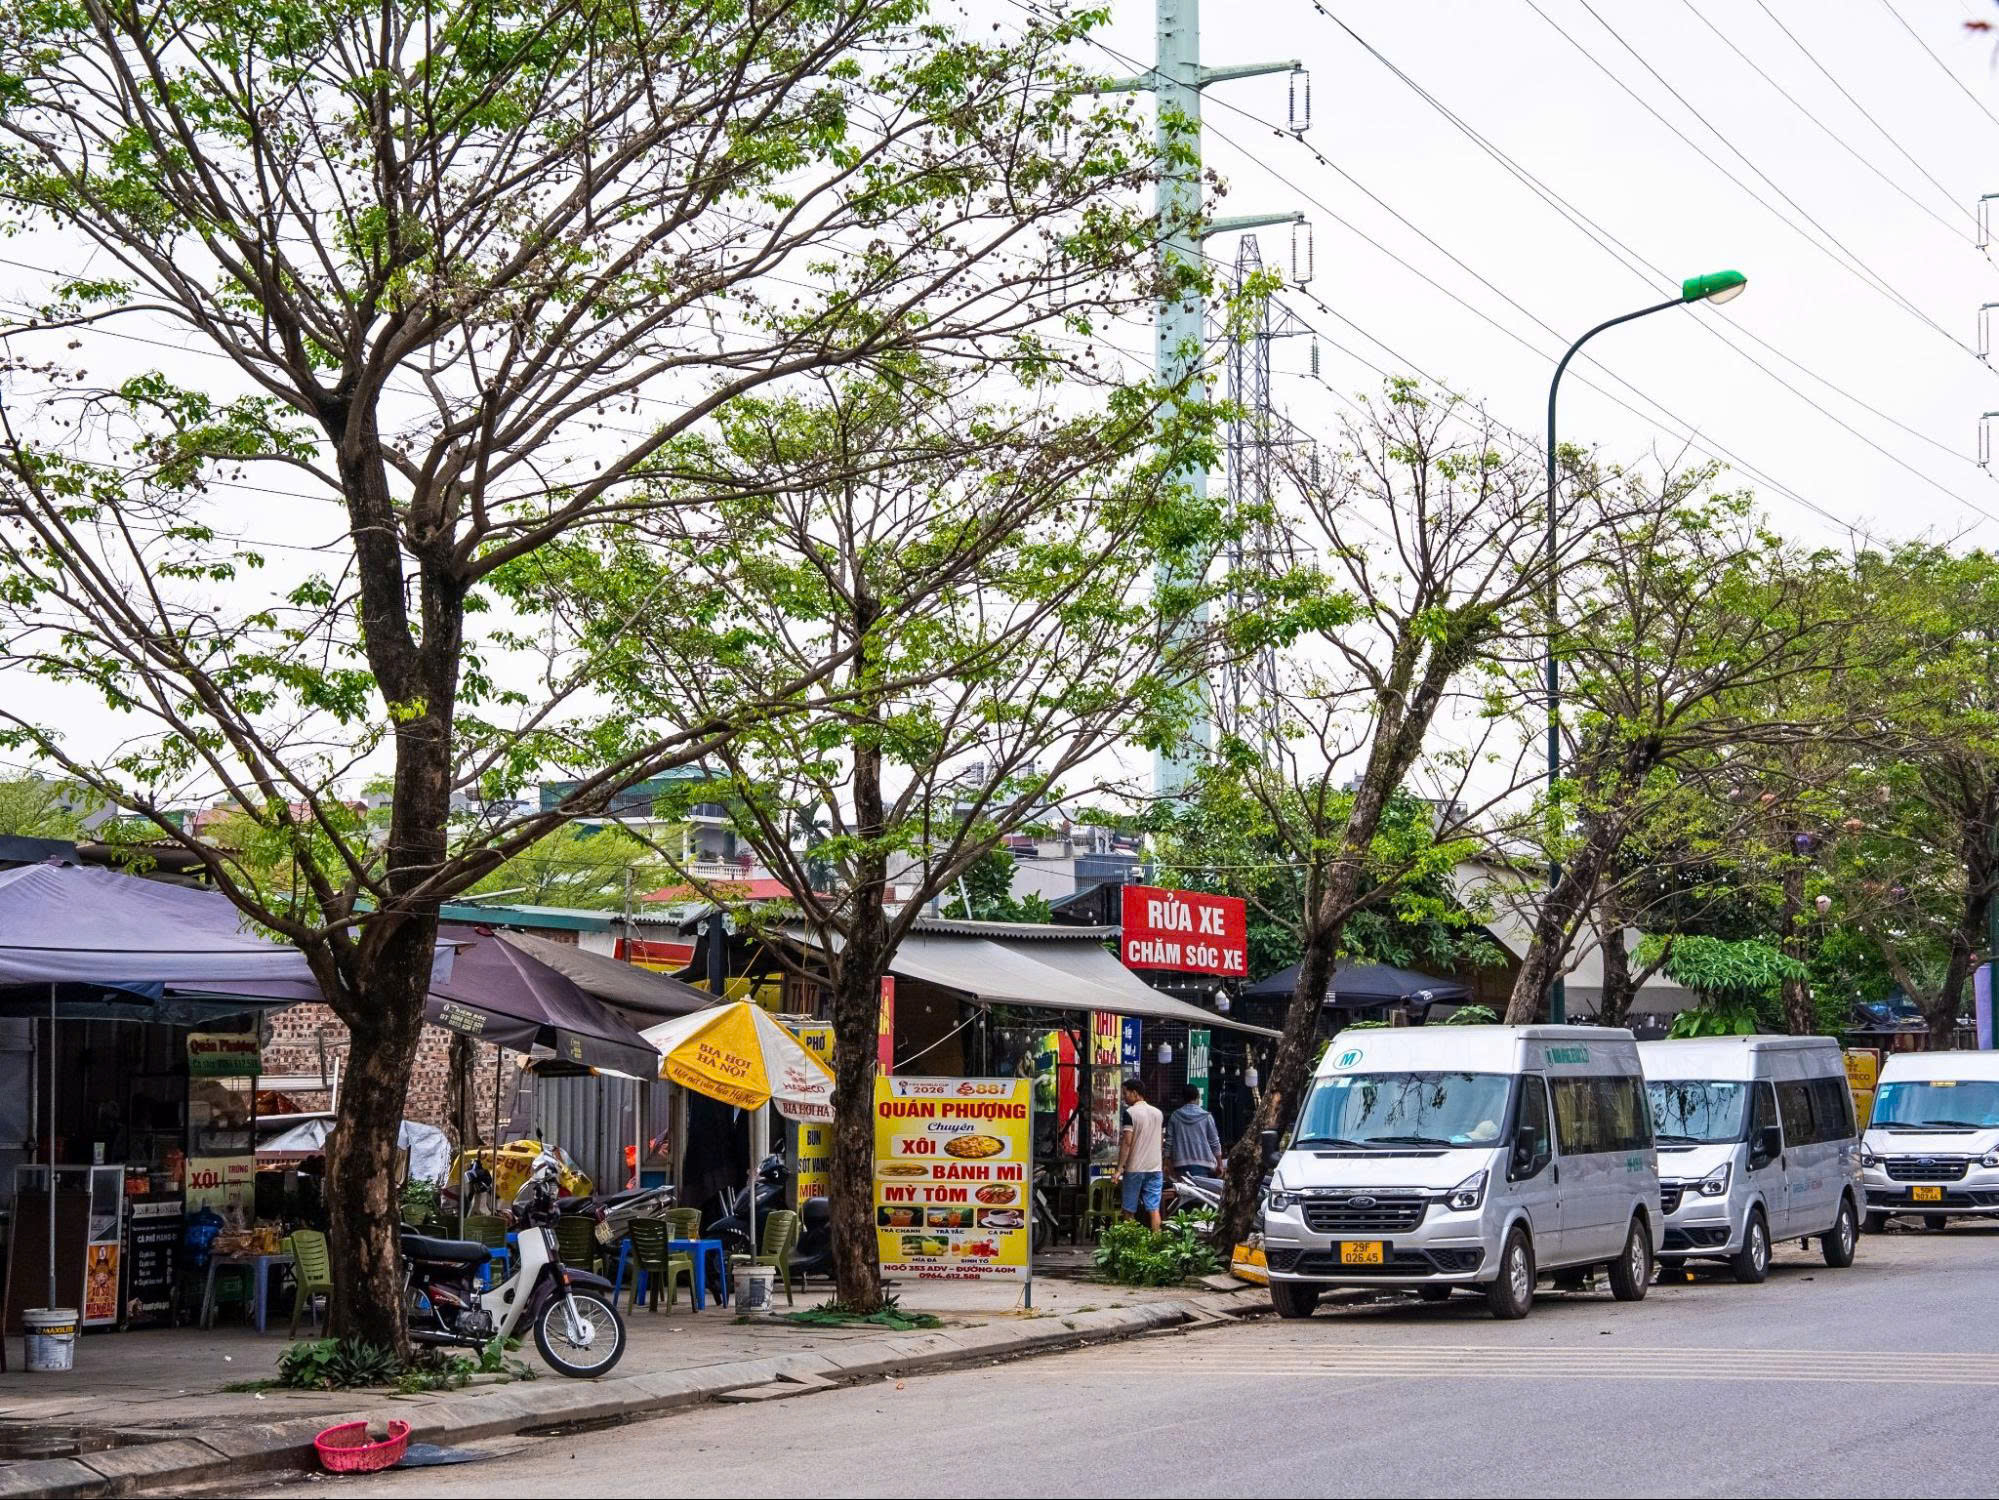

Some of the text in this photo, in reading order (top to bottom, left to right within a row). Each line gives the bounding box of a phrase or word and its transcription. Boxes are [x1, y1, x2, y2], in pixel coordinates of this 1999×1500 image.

[1148, 892, 1225, 935] RỬA XE
[1128, 938, 1243, 971] CHĂM SÓC XE
[806, 1030, 826, 1051] PHỞ
[699, 1042, 752, 1068] BIA HƠI
[1340, 1053, 1357, 1066] M
[696, 1053, 748, 1078] HÀ NỘI
[913, 1086, 945, 1094] 2026
[783, 1102, 798, 1115] BIA
[879, 1100, 1026, 1122] QUÁN PHƯỢNG
[927, 1122, 976, 1133] Chuyên
[902, 1137, 936, 1154] XÔI
[191, 1168, 219, 1190] XÔI
[932, 1161, 1023, 1181] BÁNH MÌ
[885, 1184, 968, 1202] MỲ TÔM
[1353, 1242, 1370, 1253] 29F
[1345, 1253, 1379, 1263] 026.45
[884, 1263, 908, 1271] NGÕ
[956, 1264, 993, 1273] ĐƯỜNG
